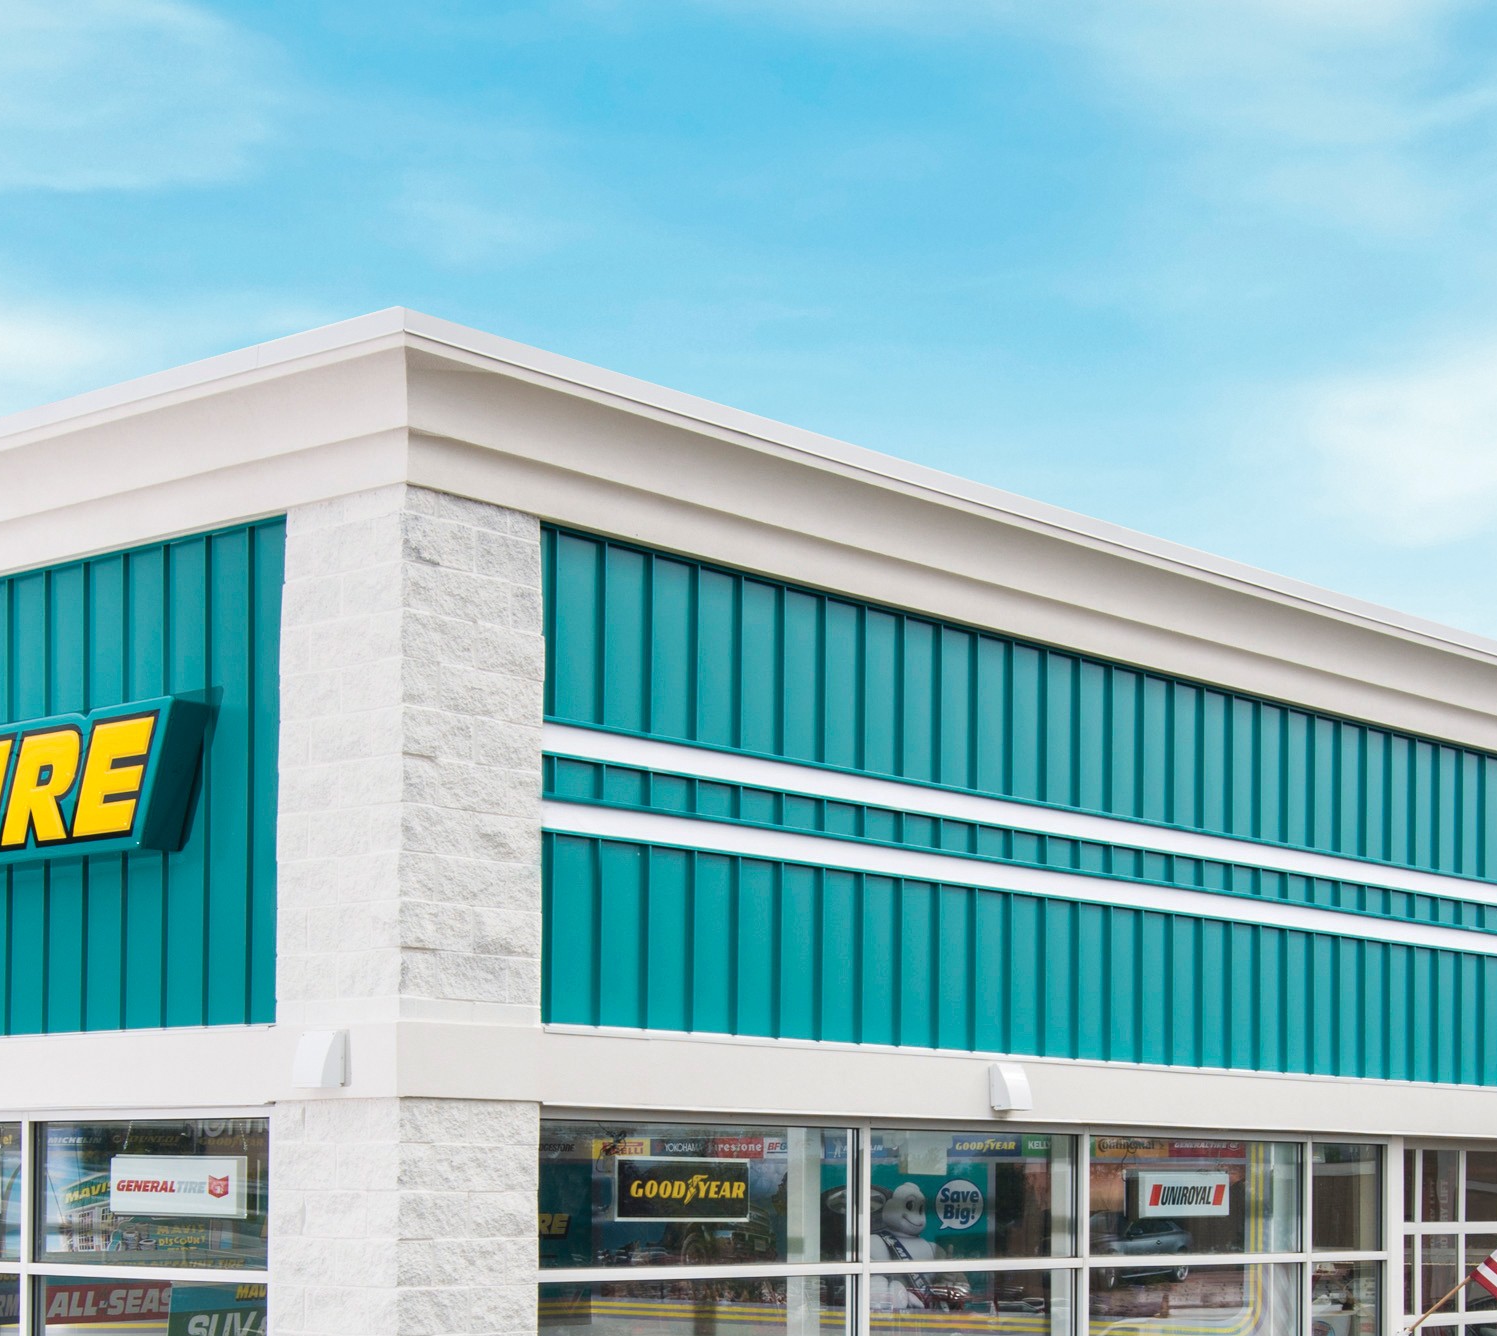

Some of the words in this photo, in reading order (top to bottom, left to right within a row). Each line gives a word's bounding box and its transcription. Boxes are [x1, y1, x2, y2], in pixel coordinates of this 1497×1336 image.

[955, 1138, 1016, 1152] GOODYEAR
[629, 1175, 746, 1203] GOODYEAR
[939, 1187, 980, 1204] Save
[1160, 1185, 1214, 1206] UNIROYAL
[942, 1203, 976, 1225] Big!
